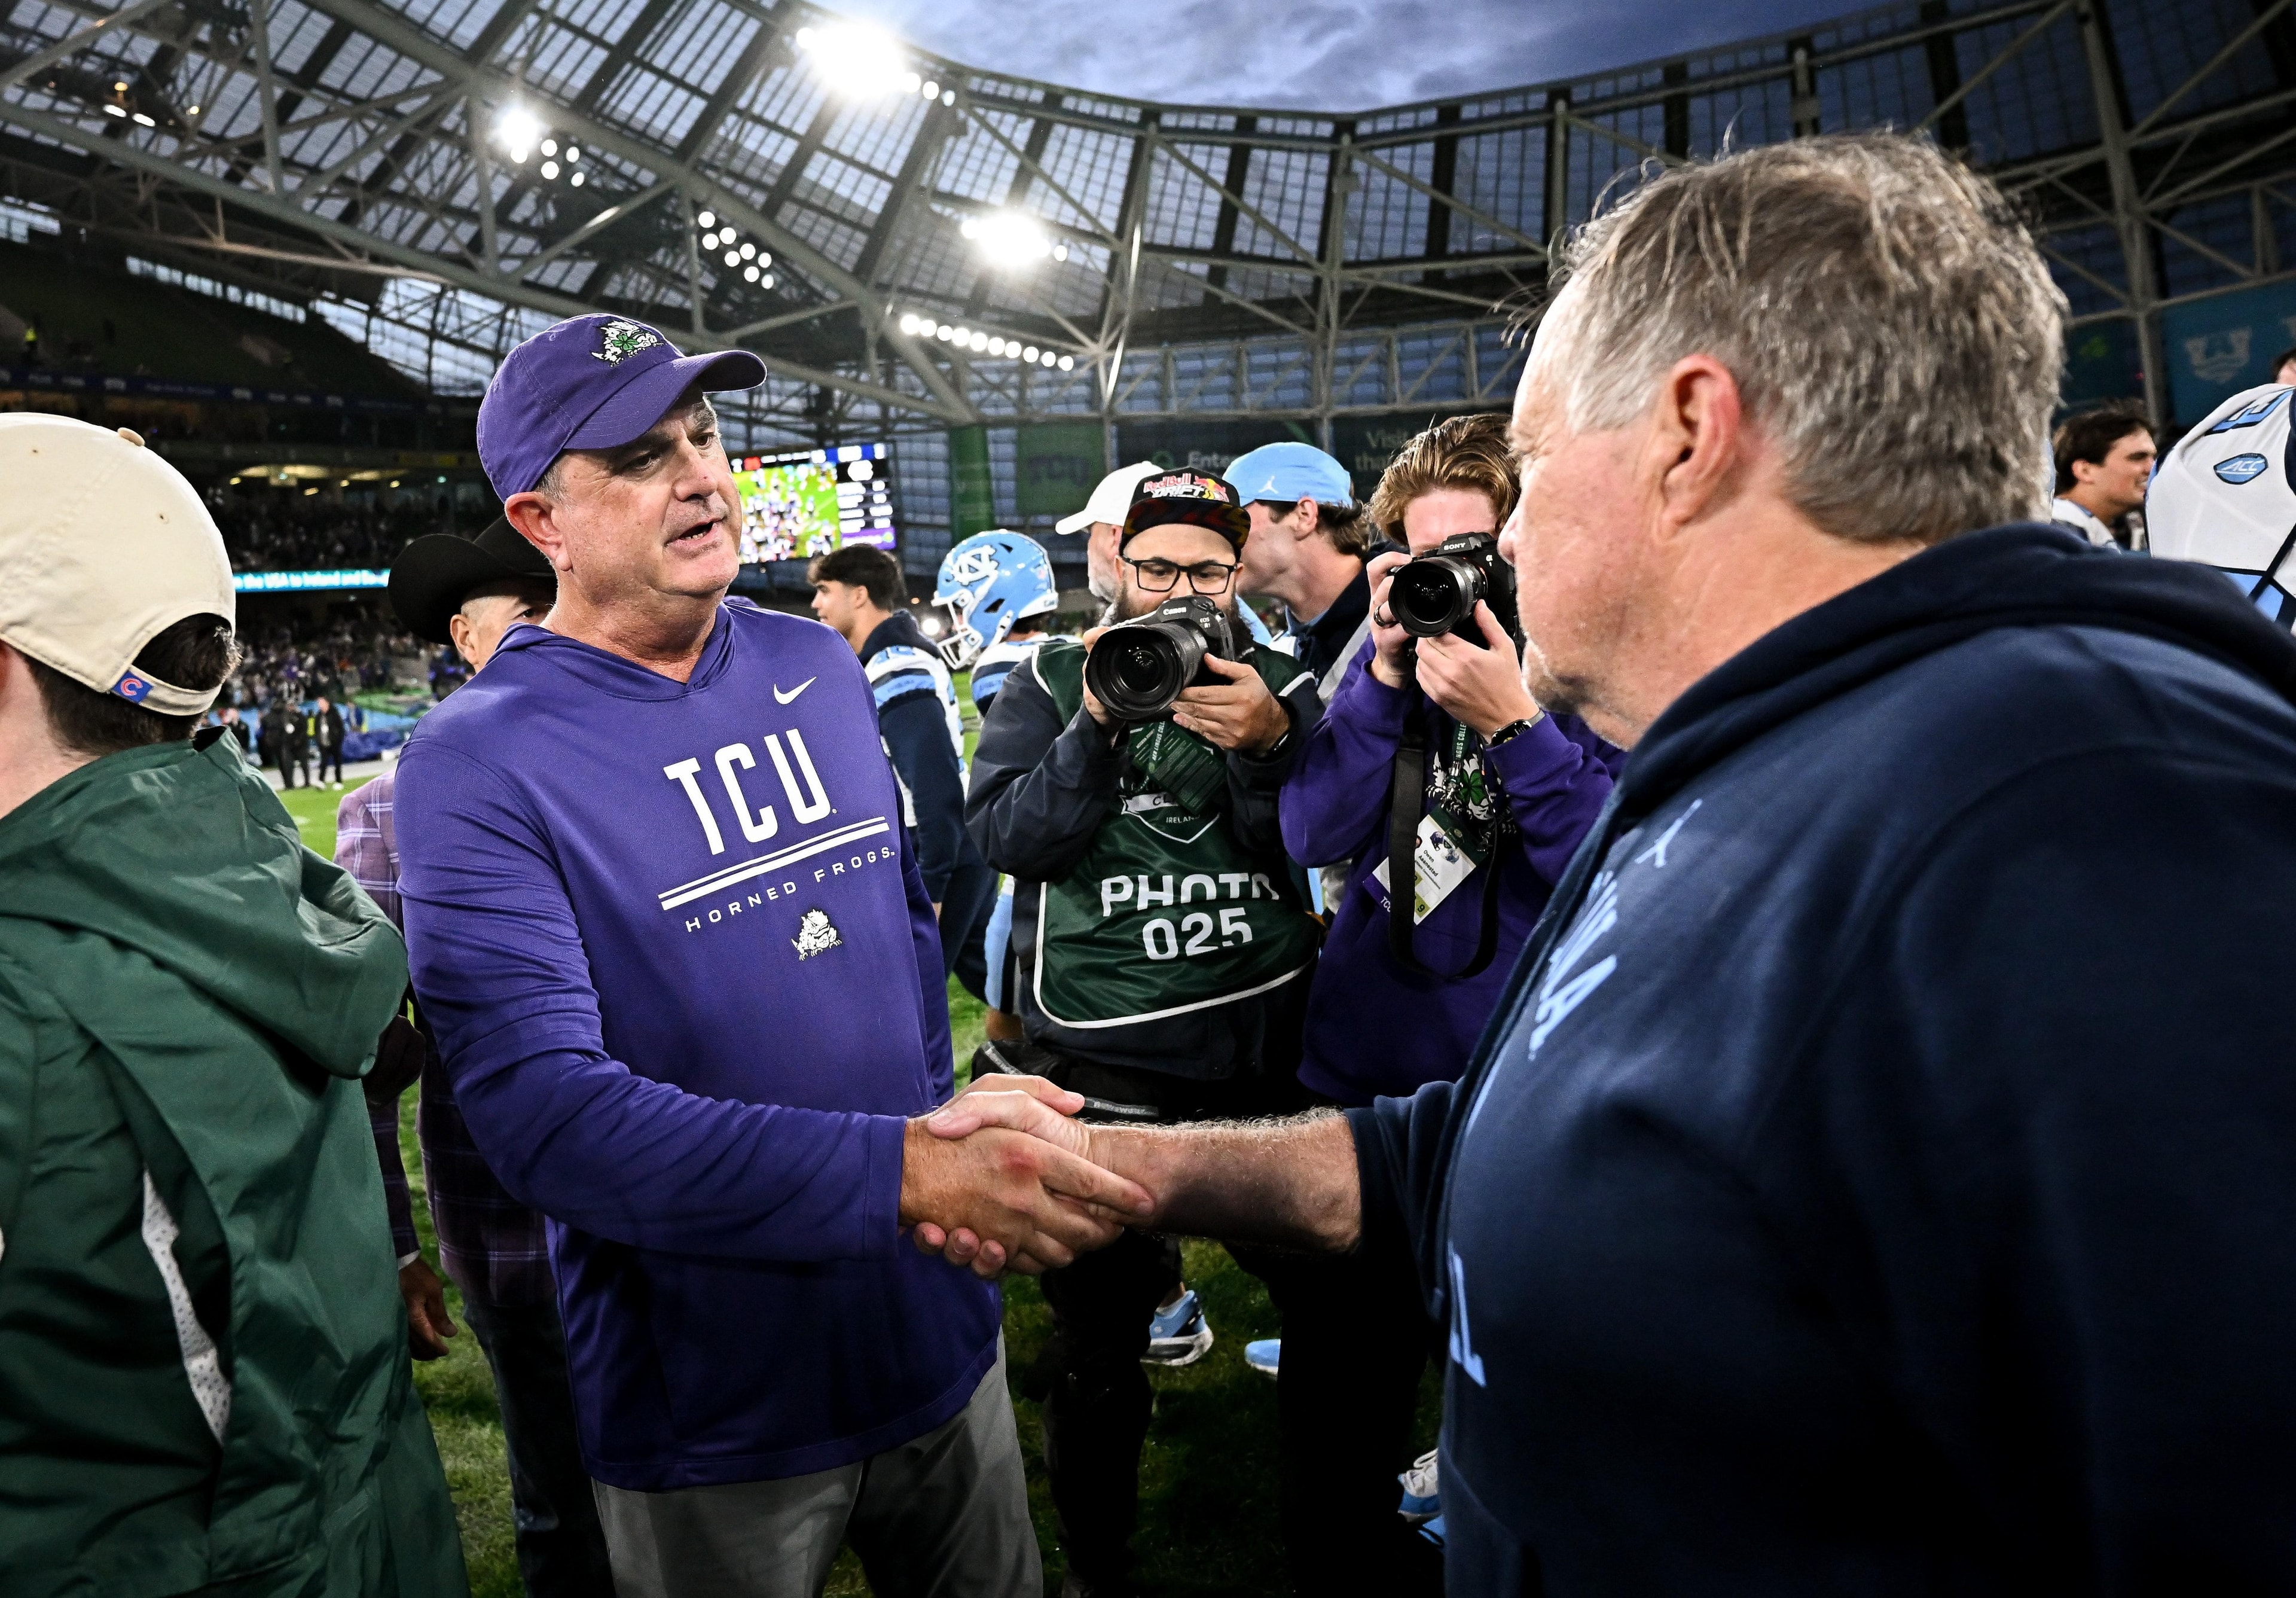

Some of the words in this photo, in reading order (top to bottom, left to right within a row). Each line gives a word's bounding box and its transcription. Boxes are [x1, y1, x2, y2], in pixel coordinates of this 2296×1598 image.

[2221, 459, 2266, 472] ACC
[1143, 477, 1167, 493] Red
[1166, 473, 1192, 487] Bull
[1151, 484, 1205, 498] DRIFT
[1163, 606, 1187, 615] Canon
[120, 678, 143, 696] C
[662, 728, 832, 856] TCU
[1424, 849, 1434, 862] Owen
[1418, 855, 1439, 877] Aaanestad
[685, 881, 797, 932] HORNED
[1417, 904, 1425, 913] 9
[1141, 907, 1253, 960] 025
